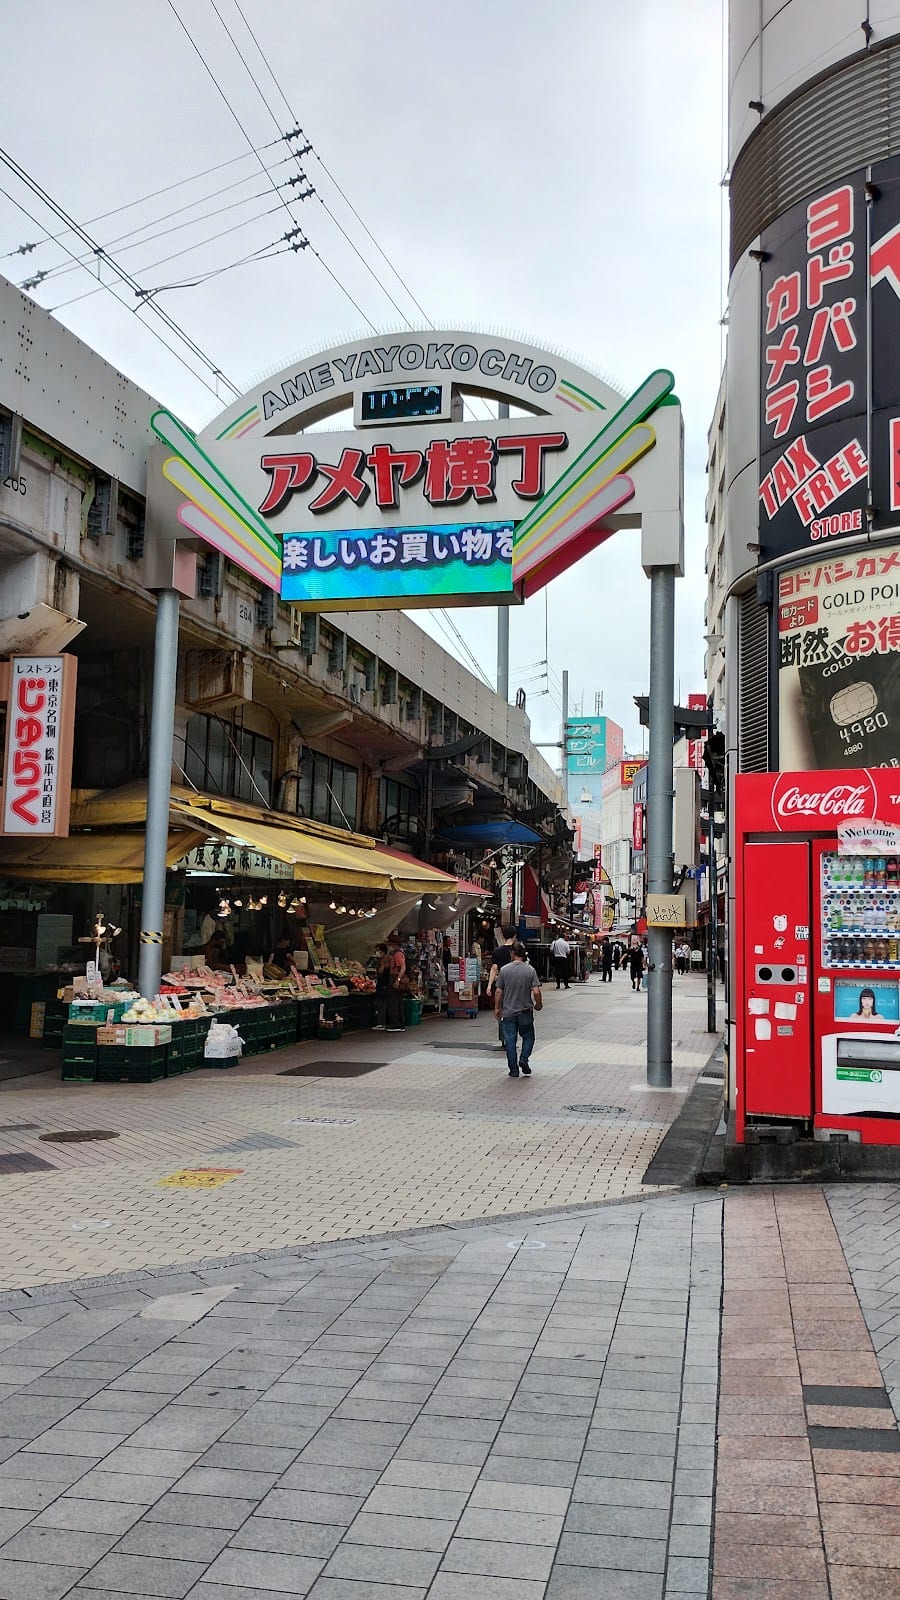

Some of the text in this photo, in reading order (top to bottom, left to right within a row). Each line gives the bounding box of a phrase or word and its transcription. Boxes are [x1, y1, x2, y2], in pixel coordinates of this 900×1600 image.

[765, 185, 857, 438] ヨドバシ カメラ
[261, 342, 558, 421] AMEYAYOKOCHO
[258, 431, 569, 515] アメヤ横丁
[758, 435, 821, 520] TAX
[791, 437, 868, 527] FREE
[809, 509, 862, 541] STORE
[283, 531, 513, 570] 楽しいお買い物を
[779, 551, 900, 598] ヨドバシカメ
[781, 600, 815, 619] 他カード
[822, 590, 865, 609] GOLD
[789, 616, 805, 628] より
[780, 626, 829, 668] 断然
[17, 664, 61, 674] レストラン
[822, 656, 853, 677] GOLD
[46, 678, 58, 739] 東京名物
[840, 711, 889, 743] 4980
[10, 678, 46, 825] じゅらく
[569, 741, 604, 751] センター
[577, 756, 599, 767] ビル
[843, 742, 864, 756] 4980
[777, 784, 871, 817] Coca-Cola
[844, 827, 895, 841] Welcome
